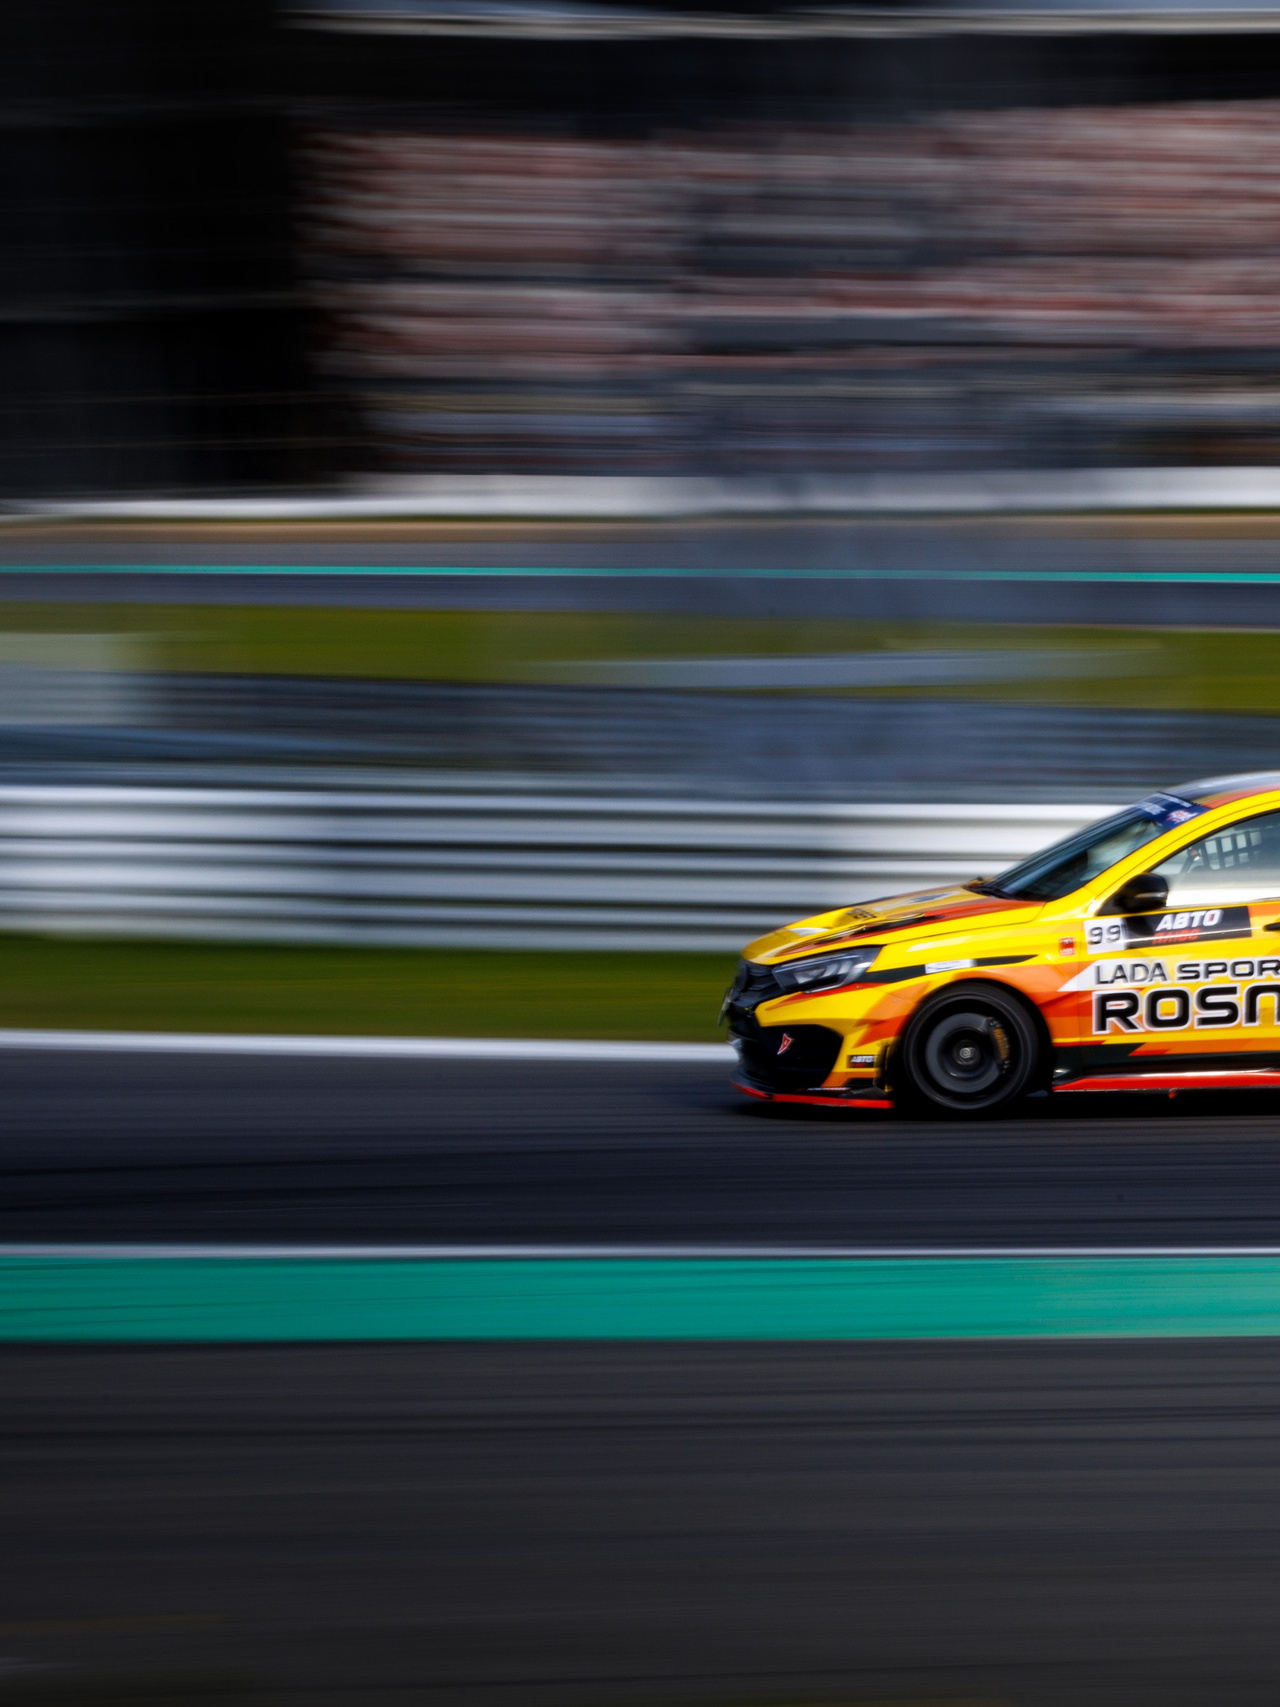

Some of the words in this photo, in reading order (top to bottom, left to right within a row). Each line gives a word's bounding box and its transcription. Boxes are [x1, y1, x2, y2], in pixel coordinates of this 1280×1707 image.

[1156, 909, 1223, 931] АВТО
[1088, 924, 1122, 945] 99
[1094, 961, 1168, 985] LADA
